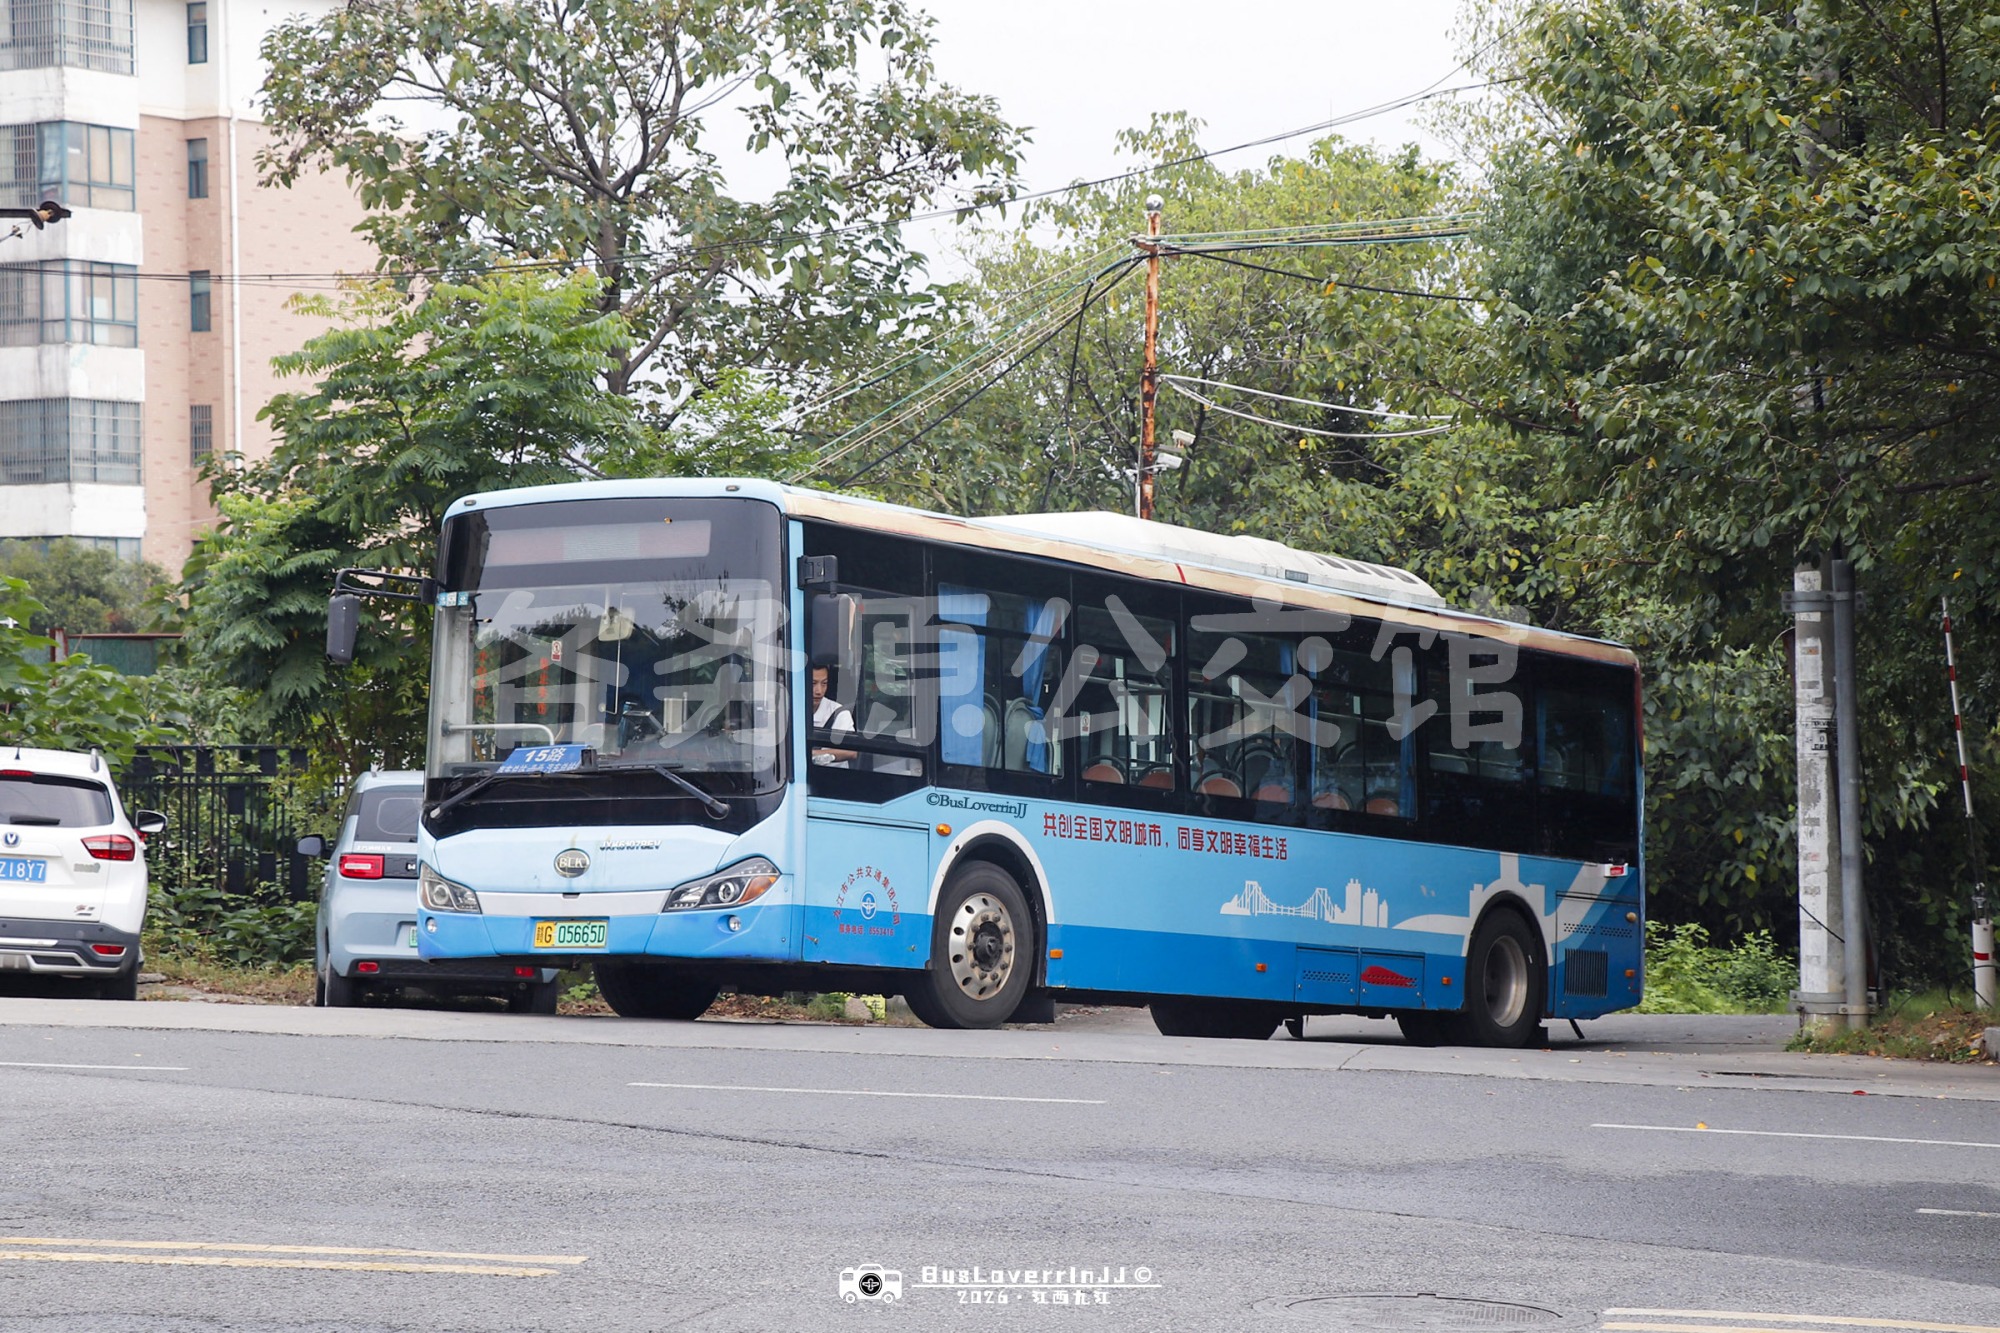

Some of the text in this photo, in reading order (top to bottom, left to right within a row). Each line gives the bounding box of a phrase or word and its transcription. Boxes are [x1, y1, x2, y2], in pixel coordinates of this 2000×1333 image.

[525, 747, 566, 762] 15路
[1044, 812, 1288, 860] 共创全国文明城市，同享文明幸福生活
[559, 857, 584, 868] BLK
[558, 925, 606, 944] 05665D
